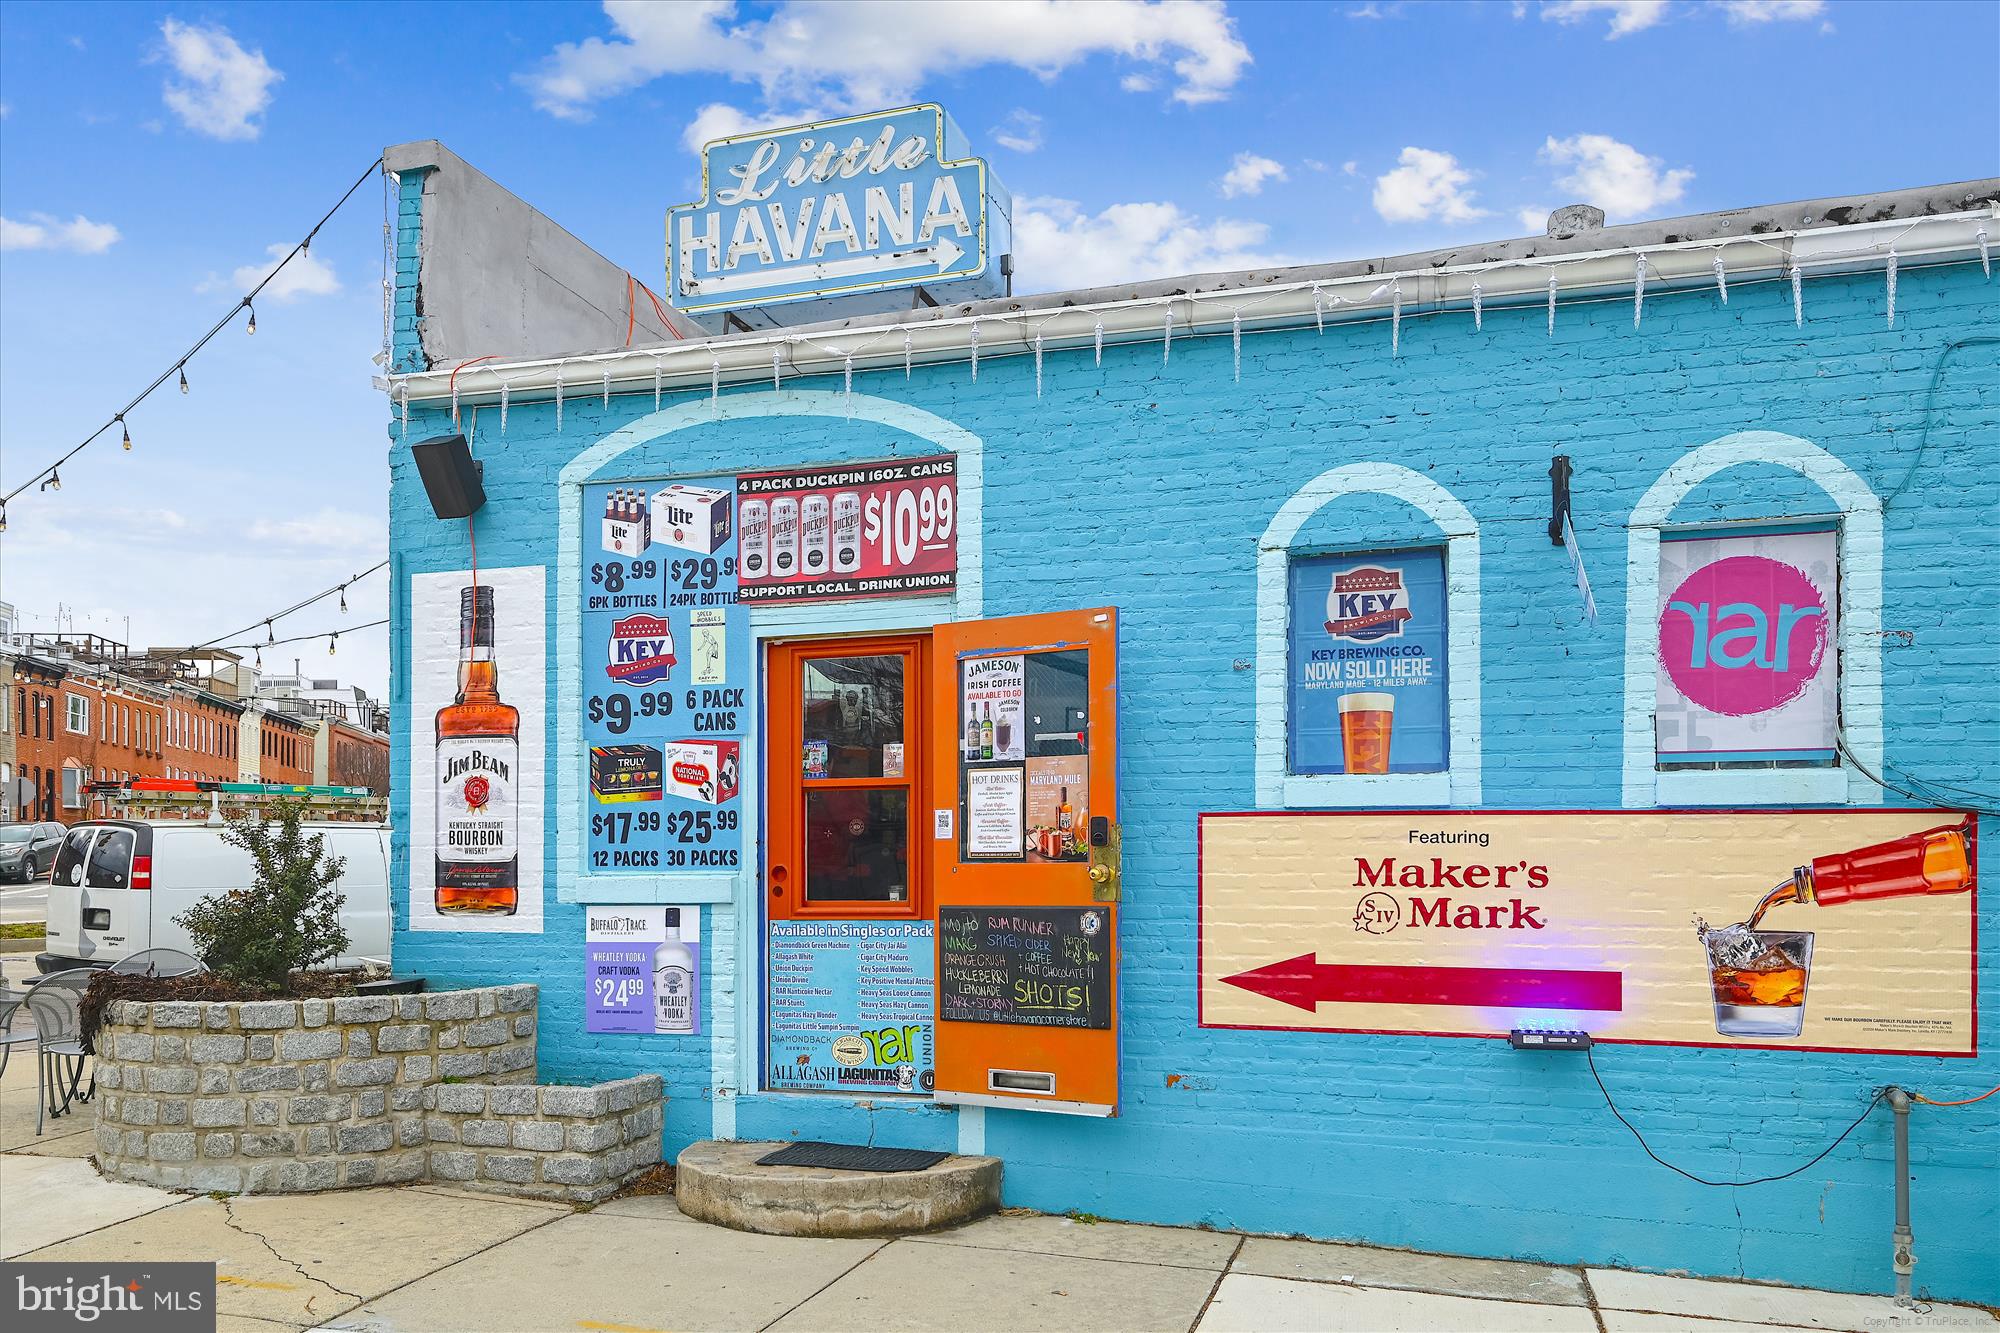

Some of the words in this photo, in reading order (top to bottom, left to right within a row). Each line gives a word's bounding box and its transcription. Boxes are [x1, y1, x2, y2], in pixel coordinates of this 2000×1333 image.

[716, 125, 929, 206] Little
[679, 175, 972, 273] HAVANA
[739, 481, 749, 492] 4
[751, 477, 793, 492] PACK
[796, 471, 865, 489] DUCKPIN
[911, 462, 953, 477] CANS
[667, 506, 694, 526] Lite
[611, 525, 628, 539] Lite
[591, 560, 657, 593] $8.99
[740, 585, 805, 598] SUPPORT
[807, 581, 856, 595] LOCAL.
[859, 578, 903, 592] DRINK
[905, 575, 953, 588] UNION.
[589, 596, 609, 609] 6PK
[613, 594, 657, 608] BOTTLES
[670, 593, 697, 607] 24PK
[1339, 593, 1398, 618] KEY
[617, 640, 666, 663] KEY
[1311, 649, 1336, 660] KEY
[1338, 646, 1400, 660] BREWING
[1402, 645, 1426, 657] CO.
[968, 660, 1020, 678] JAMESON
[1305, 661, 1341, 681] NOW
[1345, 660, 1386, 680] SOLD
[1391, 657, 1433, 677] HERE
[967, 681, 989, 690] IRISH
[992, 678, 1022, 688] COFFEE
[1305, 680, 1344, 690] MARYLAND
[1346, 679, 1366, 688] MADE
[1373, 679, 1380, 687] 12
[1383, 678, 1405, 687] MILES
[686, 690, 696, 709] 6
[702, 688, 745, 709] PACK
[967, 690, 1001, 701] AVAILABLE
[1002, 690, 1011, 698] TO
[1012, 689, 1022, 697] GO
[588, 692, 673, 734] $9.99
[694, 711, 737, 732] CANS
[443, 756, 470, 784] JIM
[472, 749, 509, 784] BEAM
[617, 757, 646, 767] TRULY
[675, 766, 706, 777] NATIONAL
[972, 775, 988, 785] HOT
[990, 774, 1019, 784] DRINKS
[1030, 775, 1063, 785] MARYLAND
[1064, 774, 1081, 784] MULE
[449, 821, 477, 829] KENTUCKY
[478, 821, 504, 829] STRAIGHT
[592, 812, 660, 844] $17.99
[667, 810, 738, 844] $25.99
[449, 830, 503, 846] BOURBON
[1408, 830, 1490, 847] Featuring
[464, 847, 489, 855] WHISKEY
[593, 851, 608, 867] 12
[614, 850, 659, 867] PACKS
[667, 850, 686, 867] 30
[691, 850, 738, 867] PACKS
[1352, 857, 1549, 889] Maker's
[1406, 897, 1546, 930] Mark
[771, 923, 826, 937] Available
[827, 923, 840, 937] in
[841, 923, 886, 940] Singles
[888, 927, 902, 937] or
[903, 923, 934, 937] Pack
[987, 916, 1010, 930] RUM
[1012, 916, 1054, 936] RUNNER
[775, 941, 811, 949] Diamondback
[811, 941, 827, 949] Green
[828, 941, 850, 949] Machine
[860, 941, 875, 950] Cigar
[875, 941, 887, 950] City
[887, 941, 896, 949] Jai
[896, 941, 907, 949] Alai
[944, 935, 977, 952] MARG
[592, 952, 624, 962] WHEATLEY
[625, 952, 646, 962] VODKA
[775, 952, 798, 961] Allagash
[860, 953, 875, 962] Cigar
[875, 953, 887, 962] City
[887, 953, 909, 961] Maduro
[944, 952, 976, 967] ORANGE
[977, 953, 1006, 967] CRUSH
[1025, 951, 1053, 965] COFFEE
[598, 966, 618, 976] CRAFT
[619, 966, 641, 976] VODKA
[775, 964, 791, 972] Union
[792, 964, 813, 973] Duckpin
[860, 965, 871, 974] Key
[872, 965, 889, 974] Speed
[890, 965, 913, 973] Wobbles
[945, 967, 1009, 985] HUCKLEBERRY
[1024, 962, 1040, 976] HOT
[775, 987, 786, 995] RAR
[787, 987, 814, 995] Nanticoke
[814, 987, 832, 995] Nectar
[860, 988, 878, 997] Heavy
[879, 988, 892, 997] Seas
[893, 989, 910, 997] Loose
[910, 989, 931, 997] Cannon
[958, 981, 1002, 997] LEMONADE
[1014, 978, 1090, 1015] SHOTS!
[660, 995, 688, 1007] WHEATLEY
[860, 1001, 878, 1009] Heavy
[893, 1001, 907, 1010] Hazy
[907, 1001, 929, 1009] Cannon
[944, 992, 972, 1009] DARK
[976, 997, 1014, 1012] STORMY
[663, 1007, 684, 1019] VODKA
[775, 1010, 802, 1019] Lagunitas
[802, 1011, 816, 1019] Hazy
[861, 1012, 878, 1021] Heavy
[893, 1012, 915, 1021] Tropical
[945, 1007, 976, 1021] FOLLOW
[979, 1009, 990, 1021] US
[775, 1022, 802, 1031] Lagunitas
[802, 1022, 817, 1030] Little
[818, 1023, 838, 1032] Sumpin
[839, 1023, 860, 1032] Sumpin
[771, 1034, 832, 1044] DIAMONDBACK
[860, 1025, 921, 1066] rar
[923, 1024, 933, 1065] UNION
[771, 1063, 835, 1081] ALLAGASH
[837, 1067, 901, 1081] LAGUNITAS
